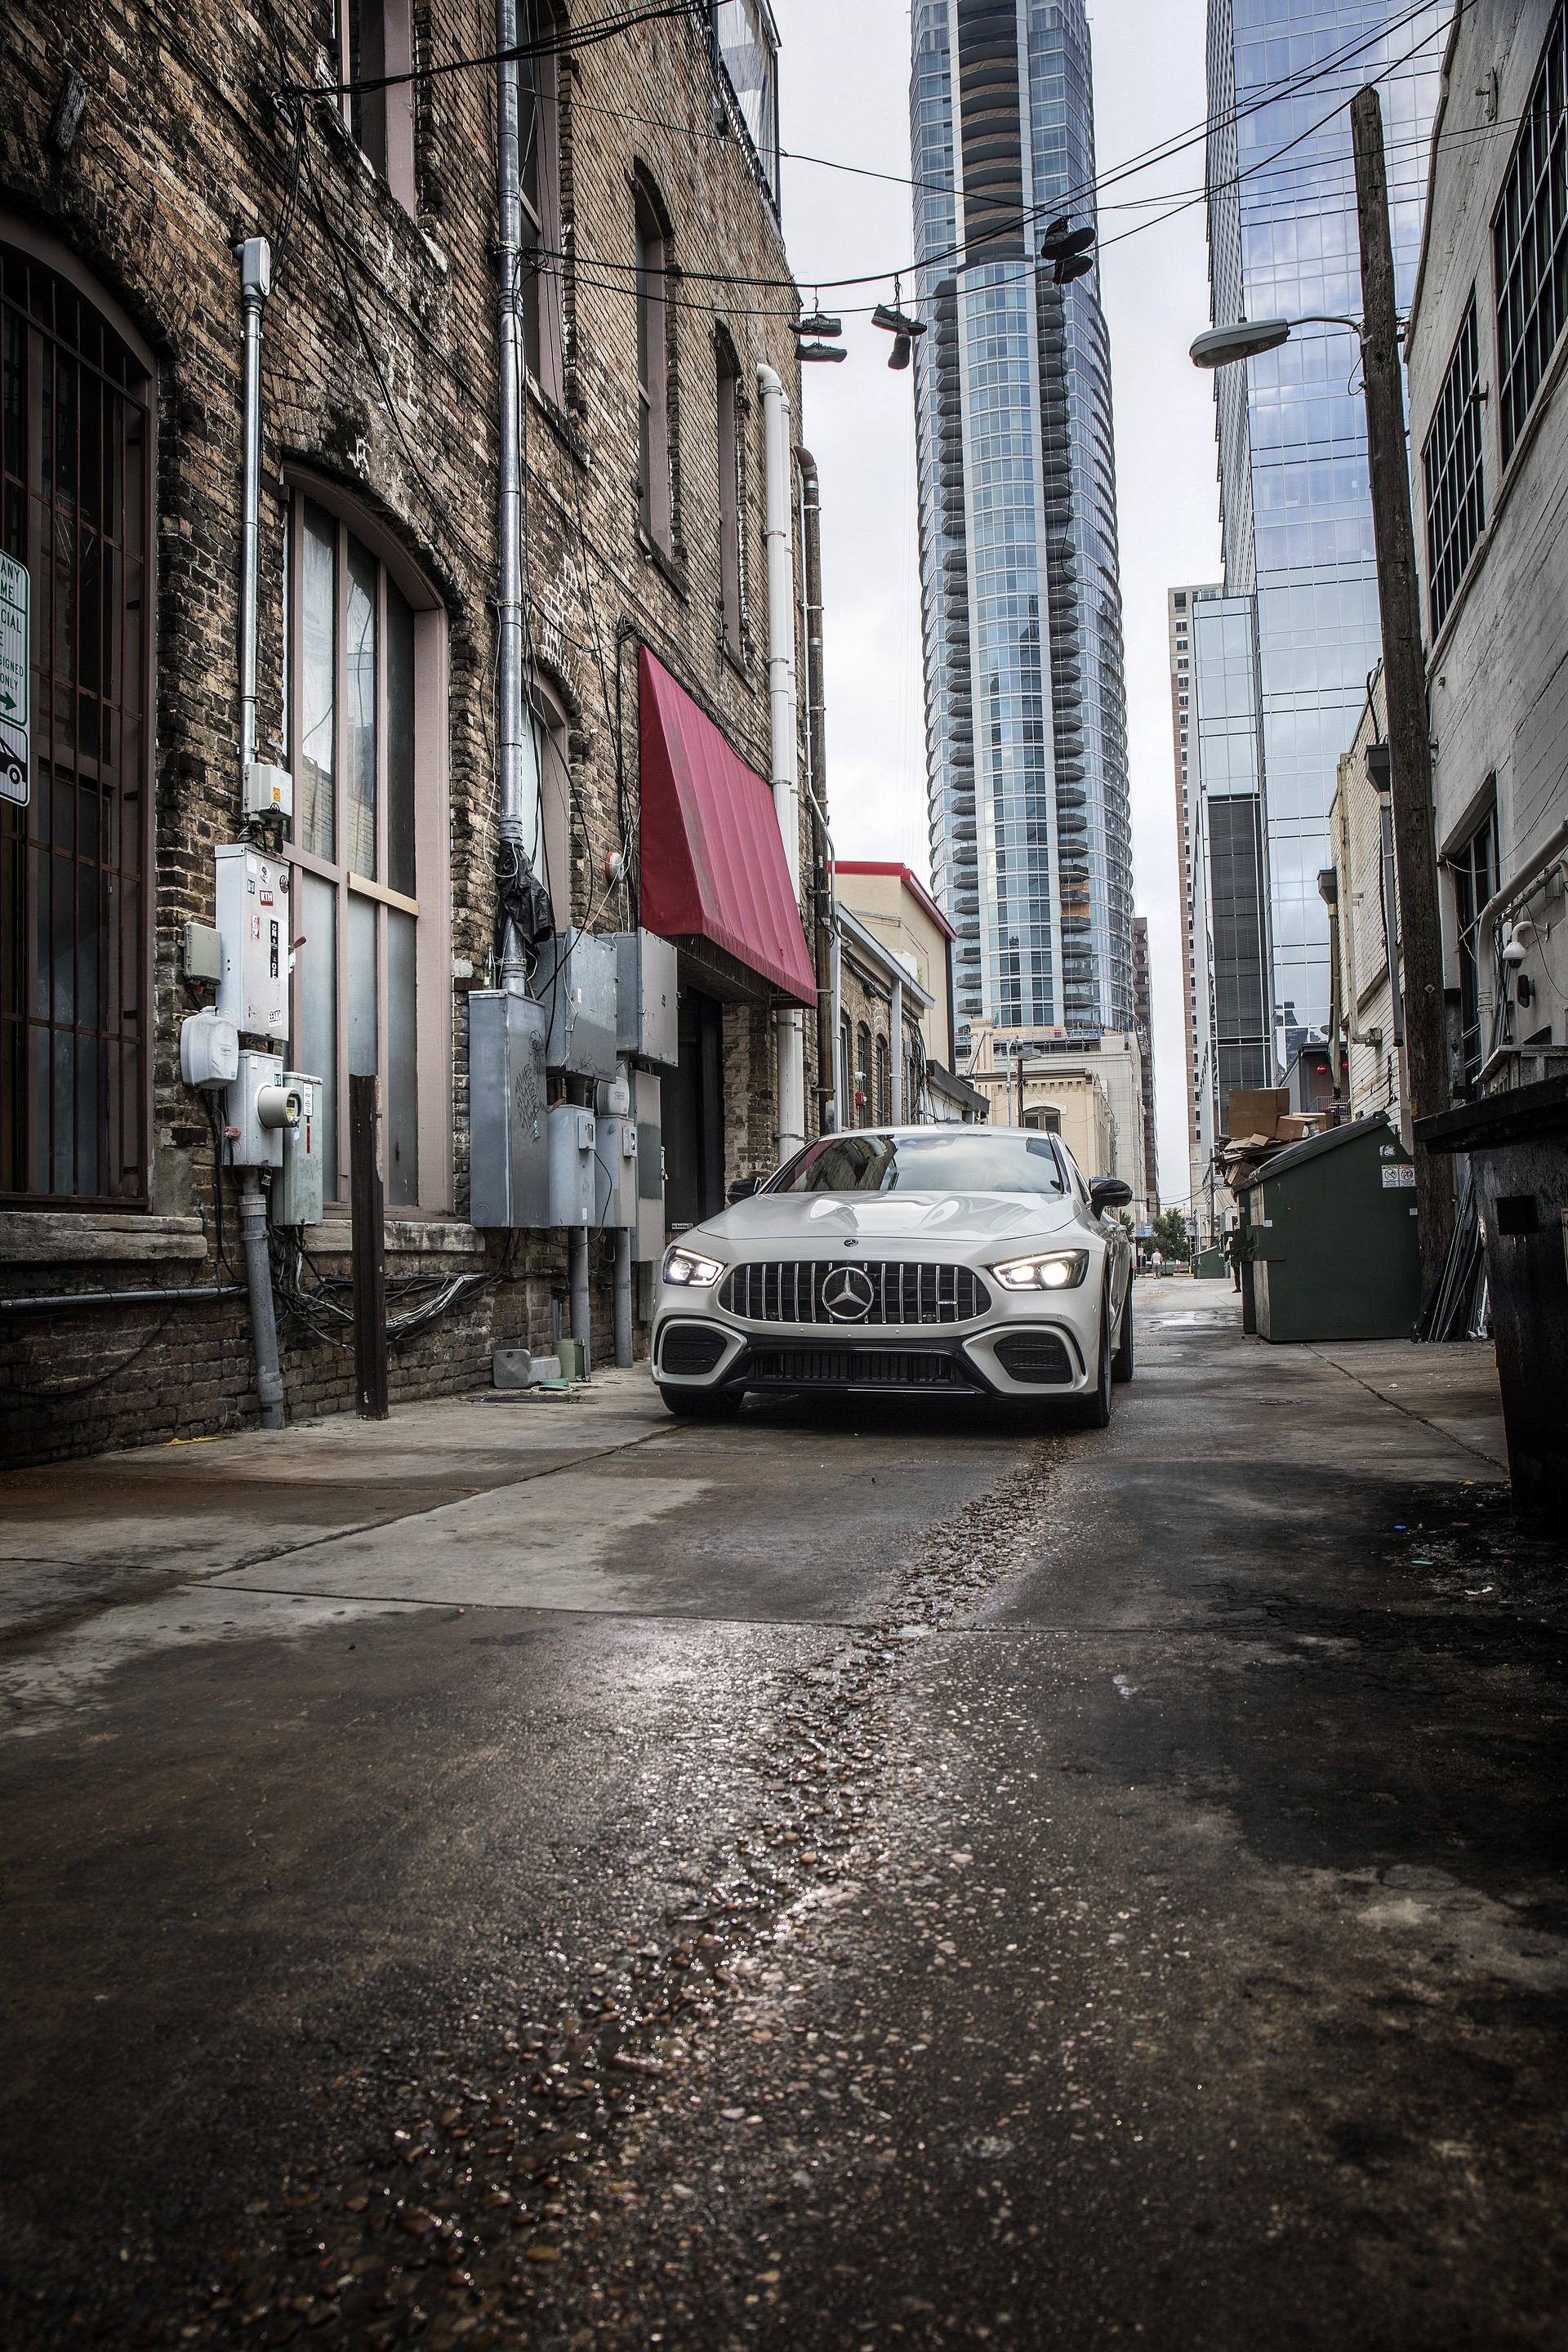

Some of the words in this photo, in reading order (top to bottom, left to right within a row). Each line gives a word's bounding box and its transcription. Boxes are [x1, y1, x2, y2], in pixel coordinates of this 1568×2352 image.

[0, 559, 20, 583] ANY
[0, 672, 18, 691] ONLY
[271, 923, 278, 938] ON
